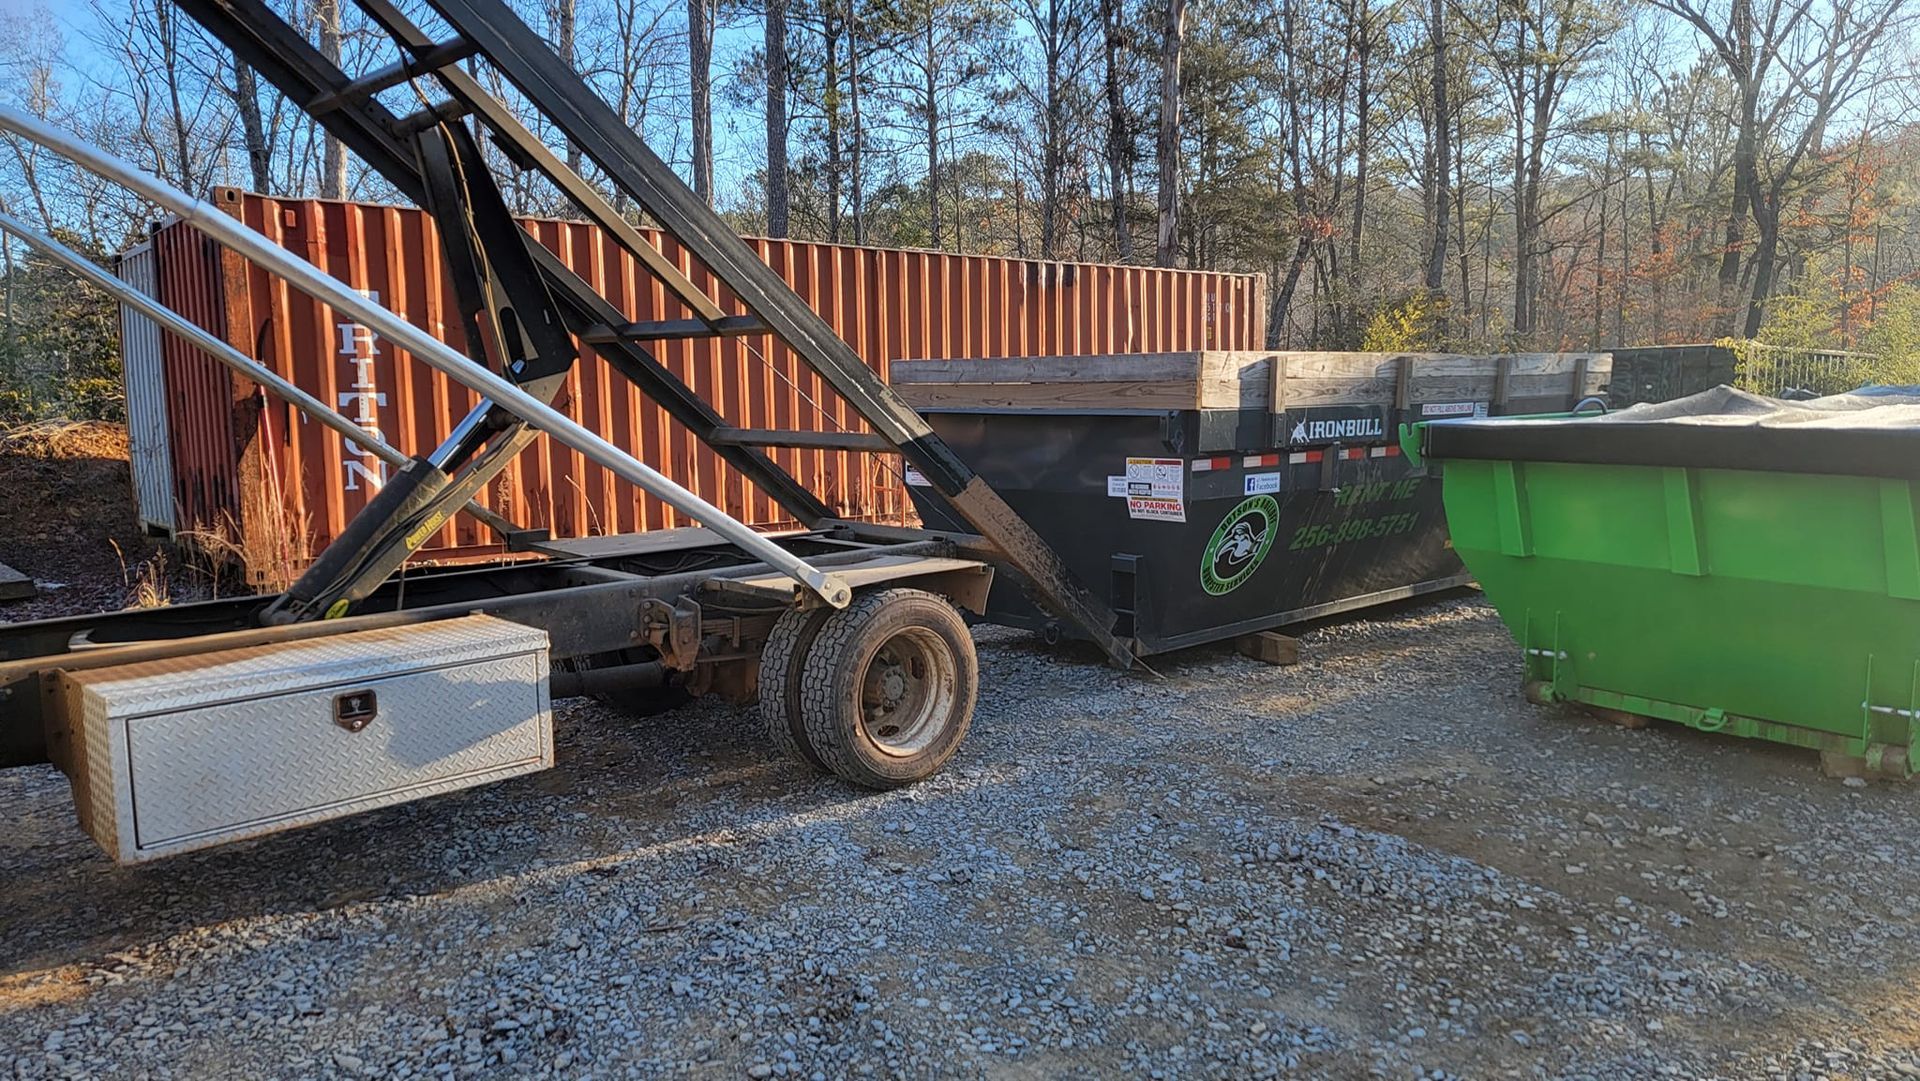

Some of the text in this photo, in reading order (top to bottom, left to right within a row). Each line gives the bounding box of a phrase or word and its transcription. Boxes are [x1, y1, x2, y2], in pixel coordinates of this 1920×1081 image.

[1309, 418, 1382, 439] IRONBULL
[1335, 479, 1421, 507] RENT ME
[1144, 501, 1182, 511] PARKING
[1289, 512, 1420, 551] 256-898-5751
